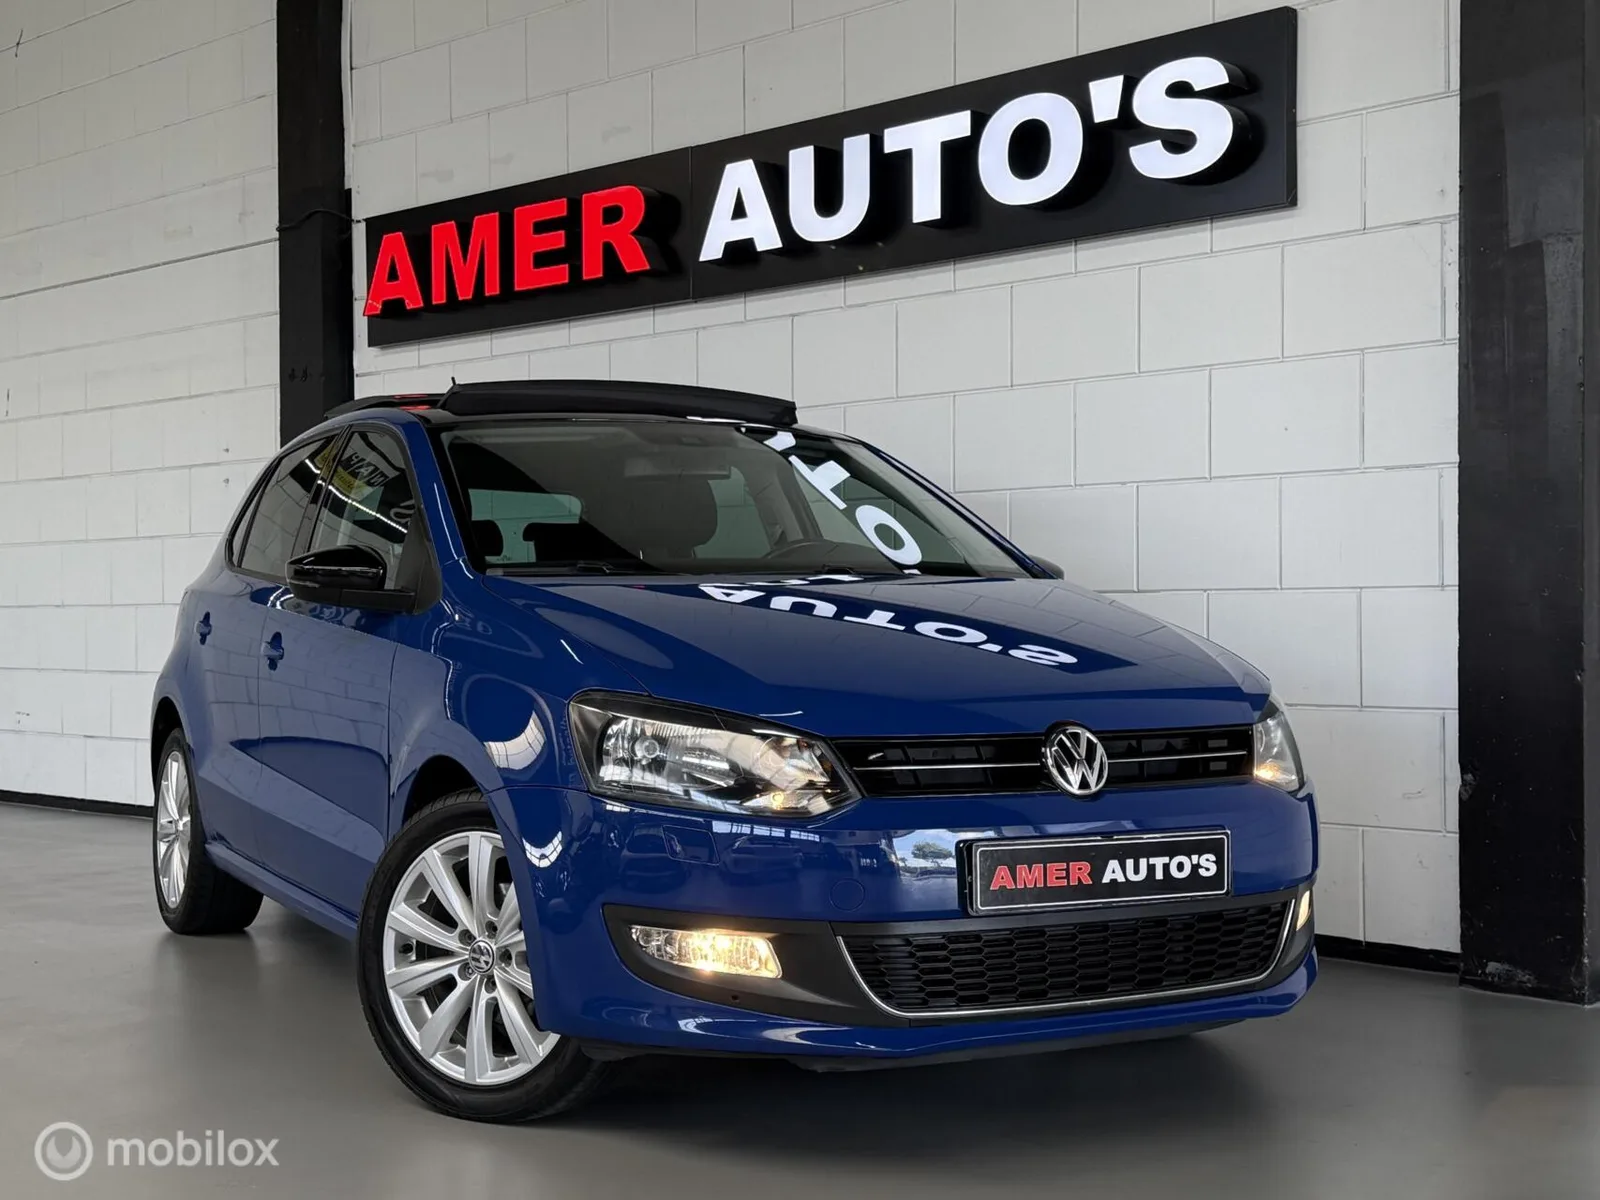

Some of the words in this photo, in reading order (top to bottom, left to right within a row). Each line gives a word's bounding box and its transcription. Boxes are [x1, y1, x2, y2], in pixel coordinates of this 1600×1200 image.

[363, 184, 651, 317] AMER
[700, 56, 1234, 262] AUTO'S
[990, 861, 1093, 890] AMER
[1101, 853, 1218, 884] AUTO'S
